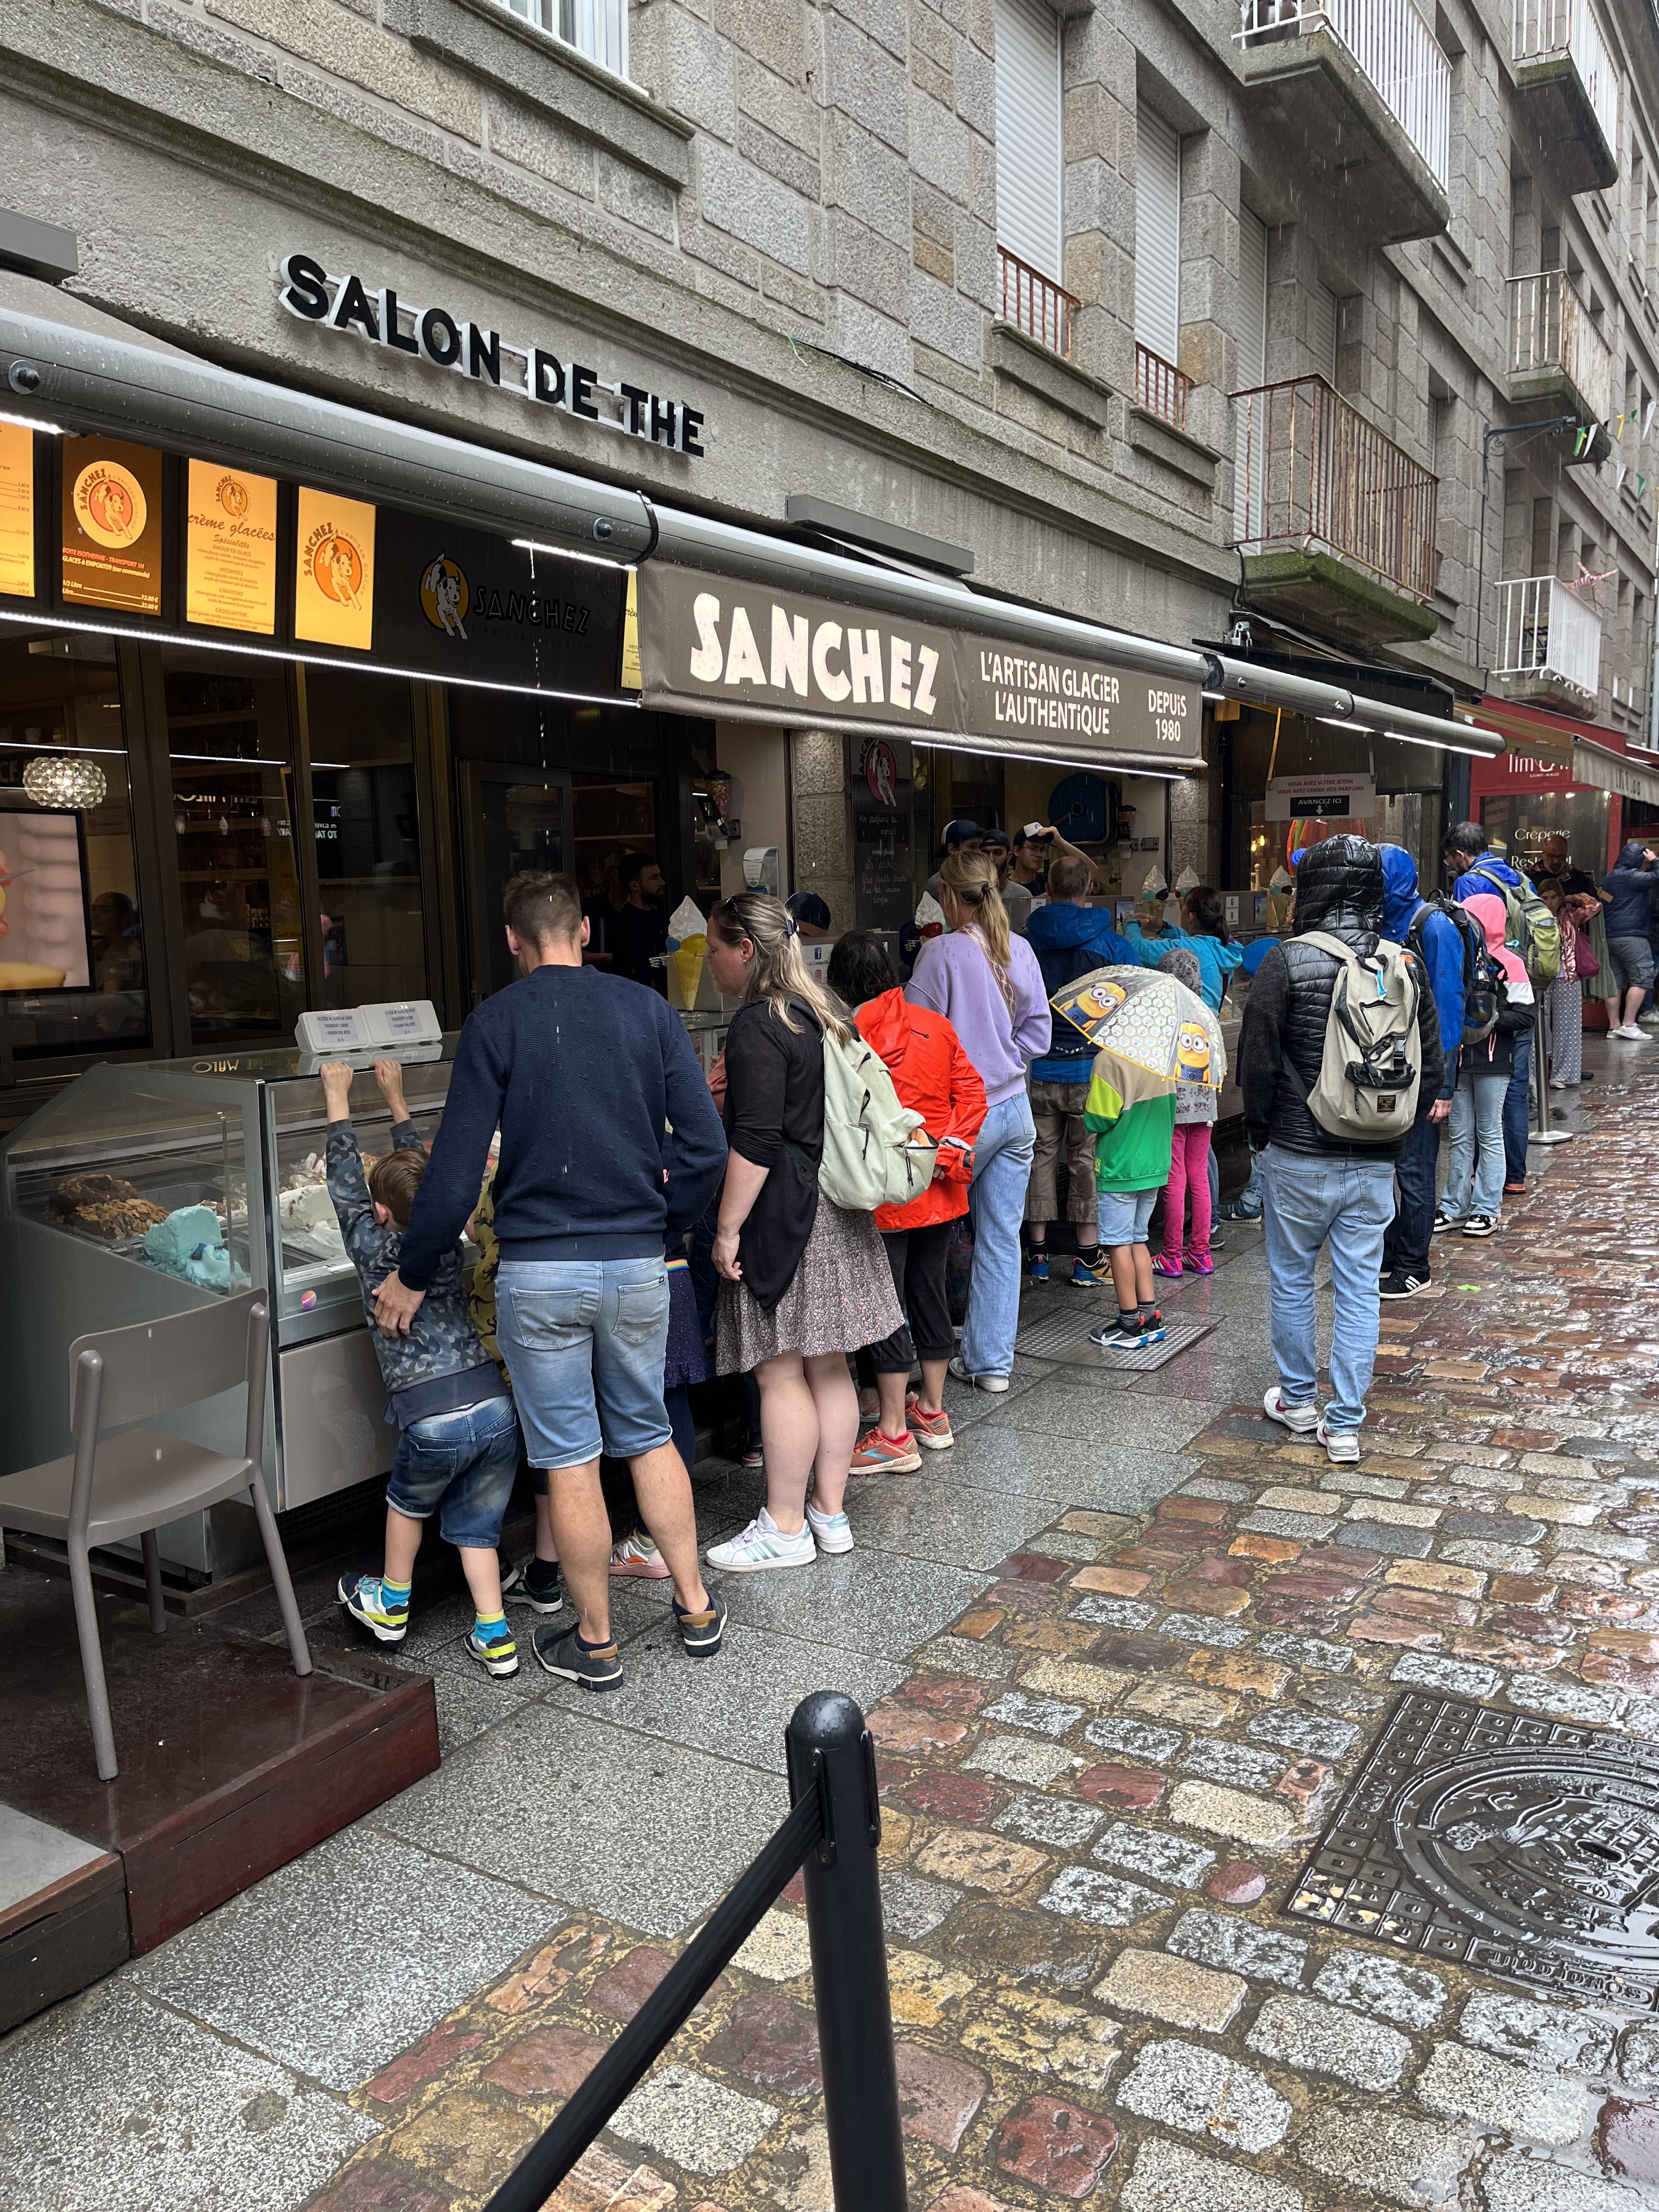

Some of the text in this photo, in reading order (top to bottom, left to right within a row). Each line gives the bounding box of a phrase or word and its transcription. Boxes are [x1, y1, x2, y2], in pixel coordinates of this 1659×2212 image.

[279, 254, 705, 458] SALON DE THE
[78, 468, 106, 510] SANCHEZ
[188, 514, 276, 541] crème glacées
[213, 534, 250, 549] Spécialités
[303, 522, 334, 576] SANCHEZ
[63, 555, 81, 565] GLACES
[86, 560, 112, 571] EMPORTER
[109, 556, 137, 568] TRANSPORT
[63, 587, 74, 595] Litre
[71, 581, 83, 589] Litre
[219, 588, 244, 596] CARATCHO
[472, 584, 592, 637] SANCHEZ
[690, 592, 939, 715] SANCHEZ
[1154, 718, 1181, 742] 1980
